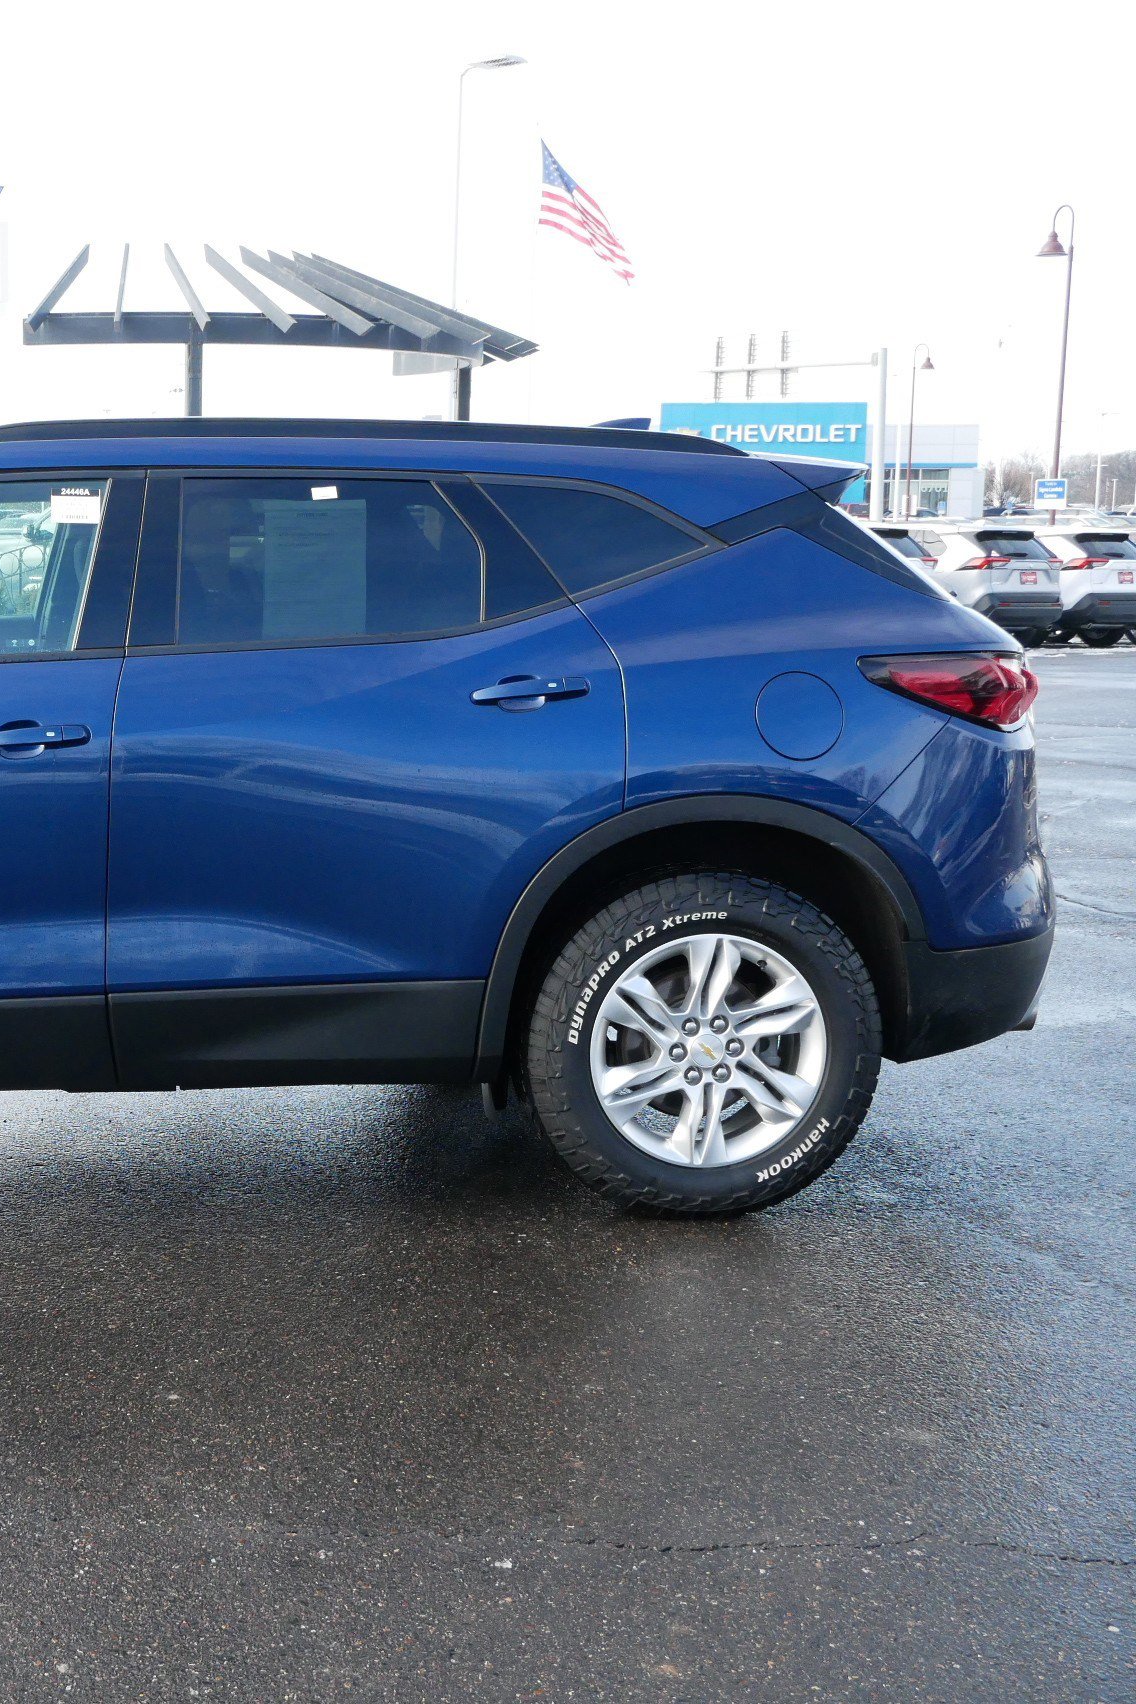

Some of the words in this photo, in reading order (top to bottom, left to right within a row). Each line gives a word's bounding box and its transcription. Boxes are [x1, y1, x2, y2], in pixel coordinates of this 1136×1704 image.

[711, 424, 862, 443] CHEVROLET
[624, 925, 657, 952] AT2
[662, 910, 728, 930] Xtreme
